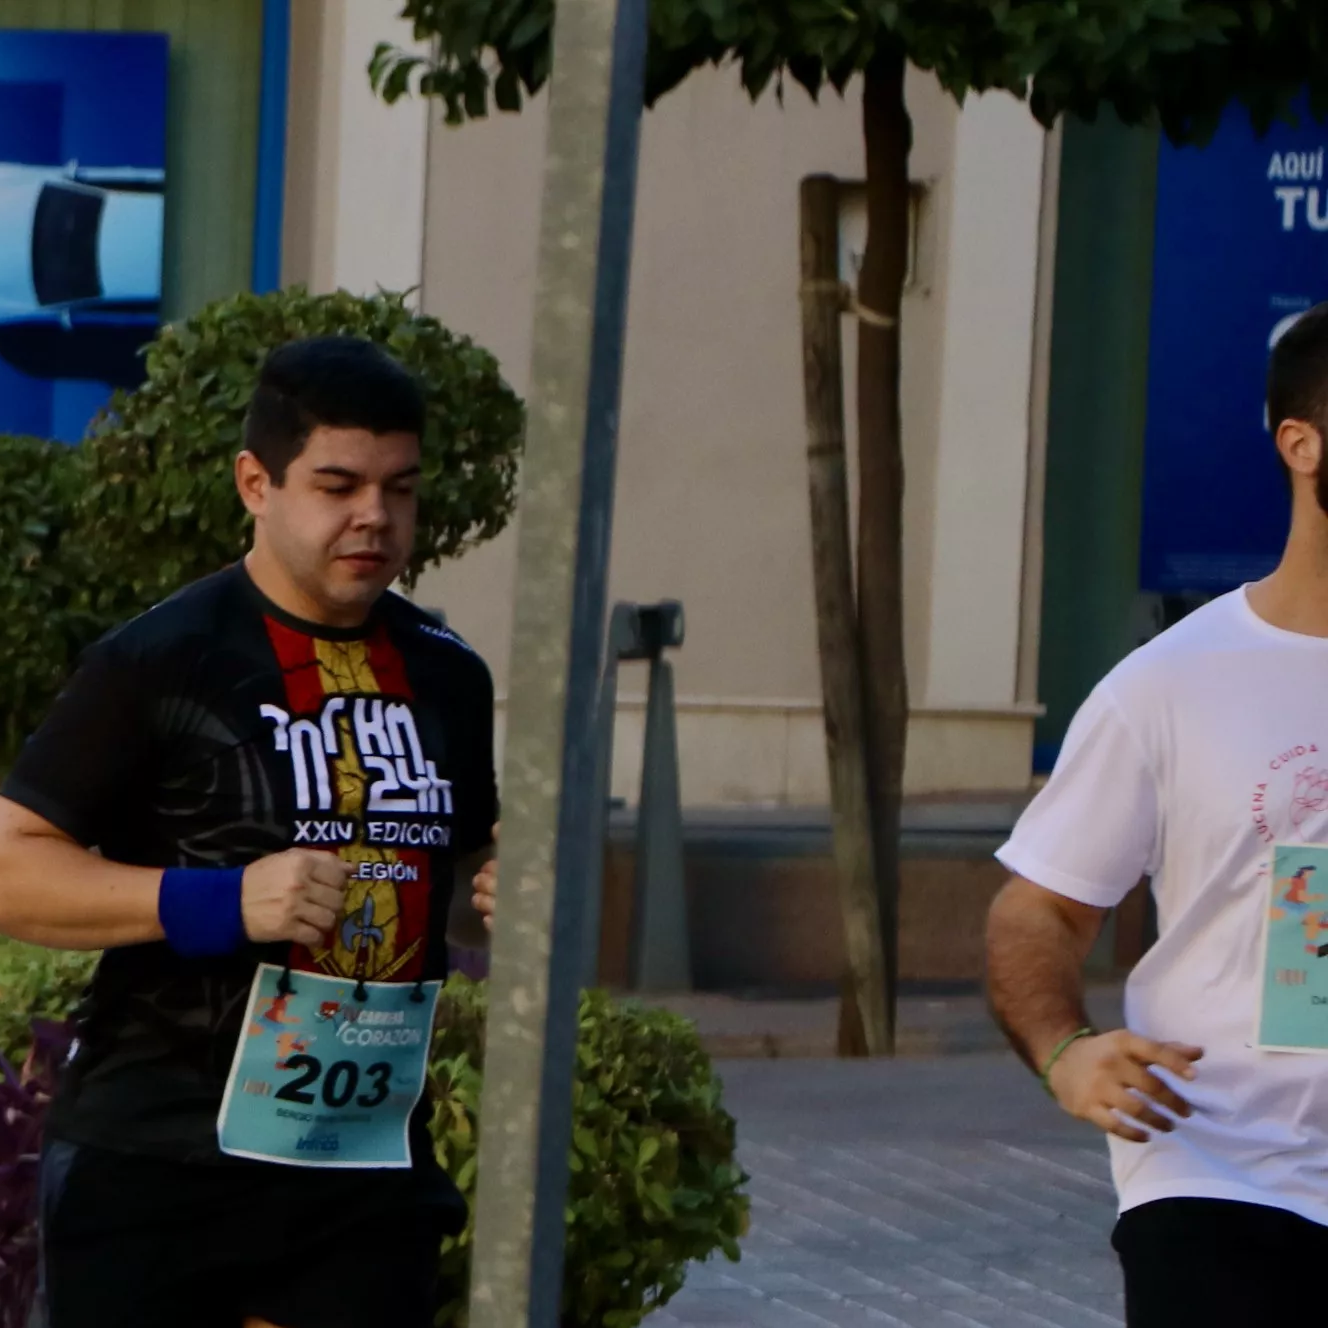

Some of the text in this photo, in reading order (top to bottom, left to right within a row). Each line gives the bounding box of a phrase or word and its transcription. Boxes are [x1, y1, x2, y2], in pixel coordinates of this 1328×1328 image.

[1269, 743, 1319, 771] CUIDA
[293, 818, 451, 847] XXIV EDICIÓN
[275, 1054, 393, 1110] 203
